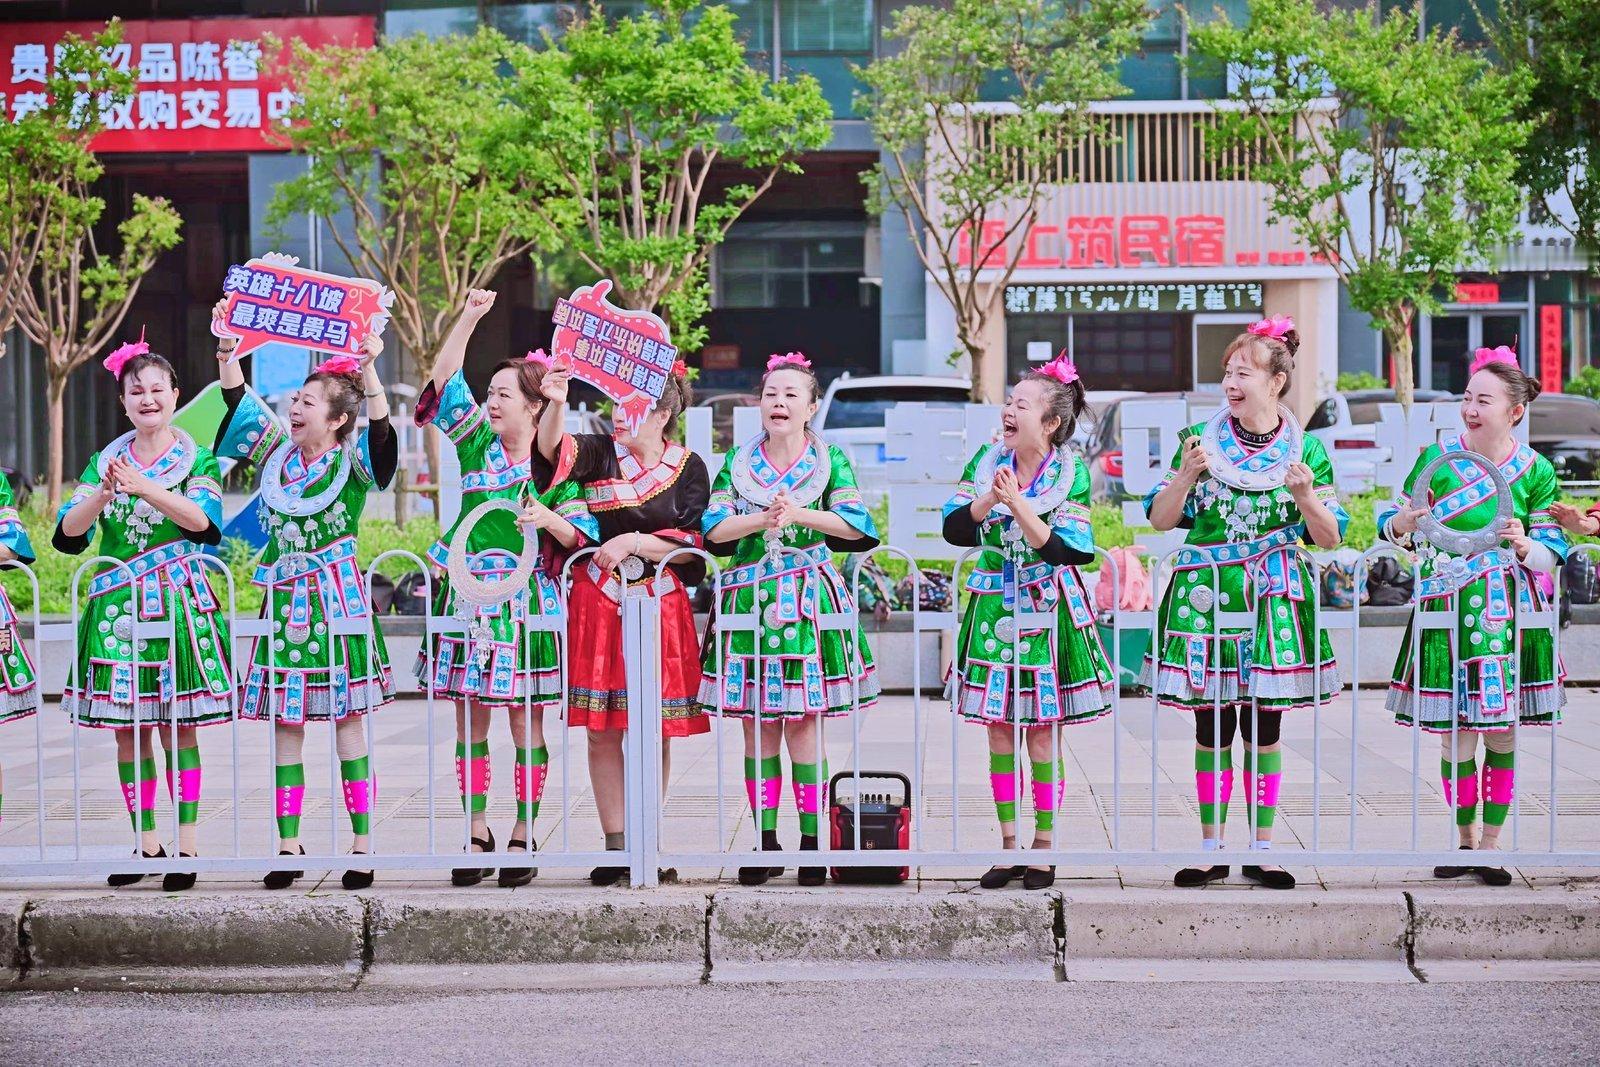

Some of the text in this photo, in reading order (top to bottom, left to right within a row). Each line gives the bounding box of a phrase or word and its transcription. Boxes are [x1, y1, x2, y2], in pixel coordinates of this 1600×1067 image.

[225, 266, 346, 314] 英雄十八坡
[231, 301, 349, 347] 最爽是贵马
[552, 300, 676, 371] 跑得快乐才是本质
[574, 338, 667, 398] 跑得快是本事
